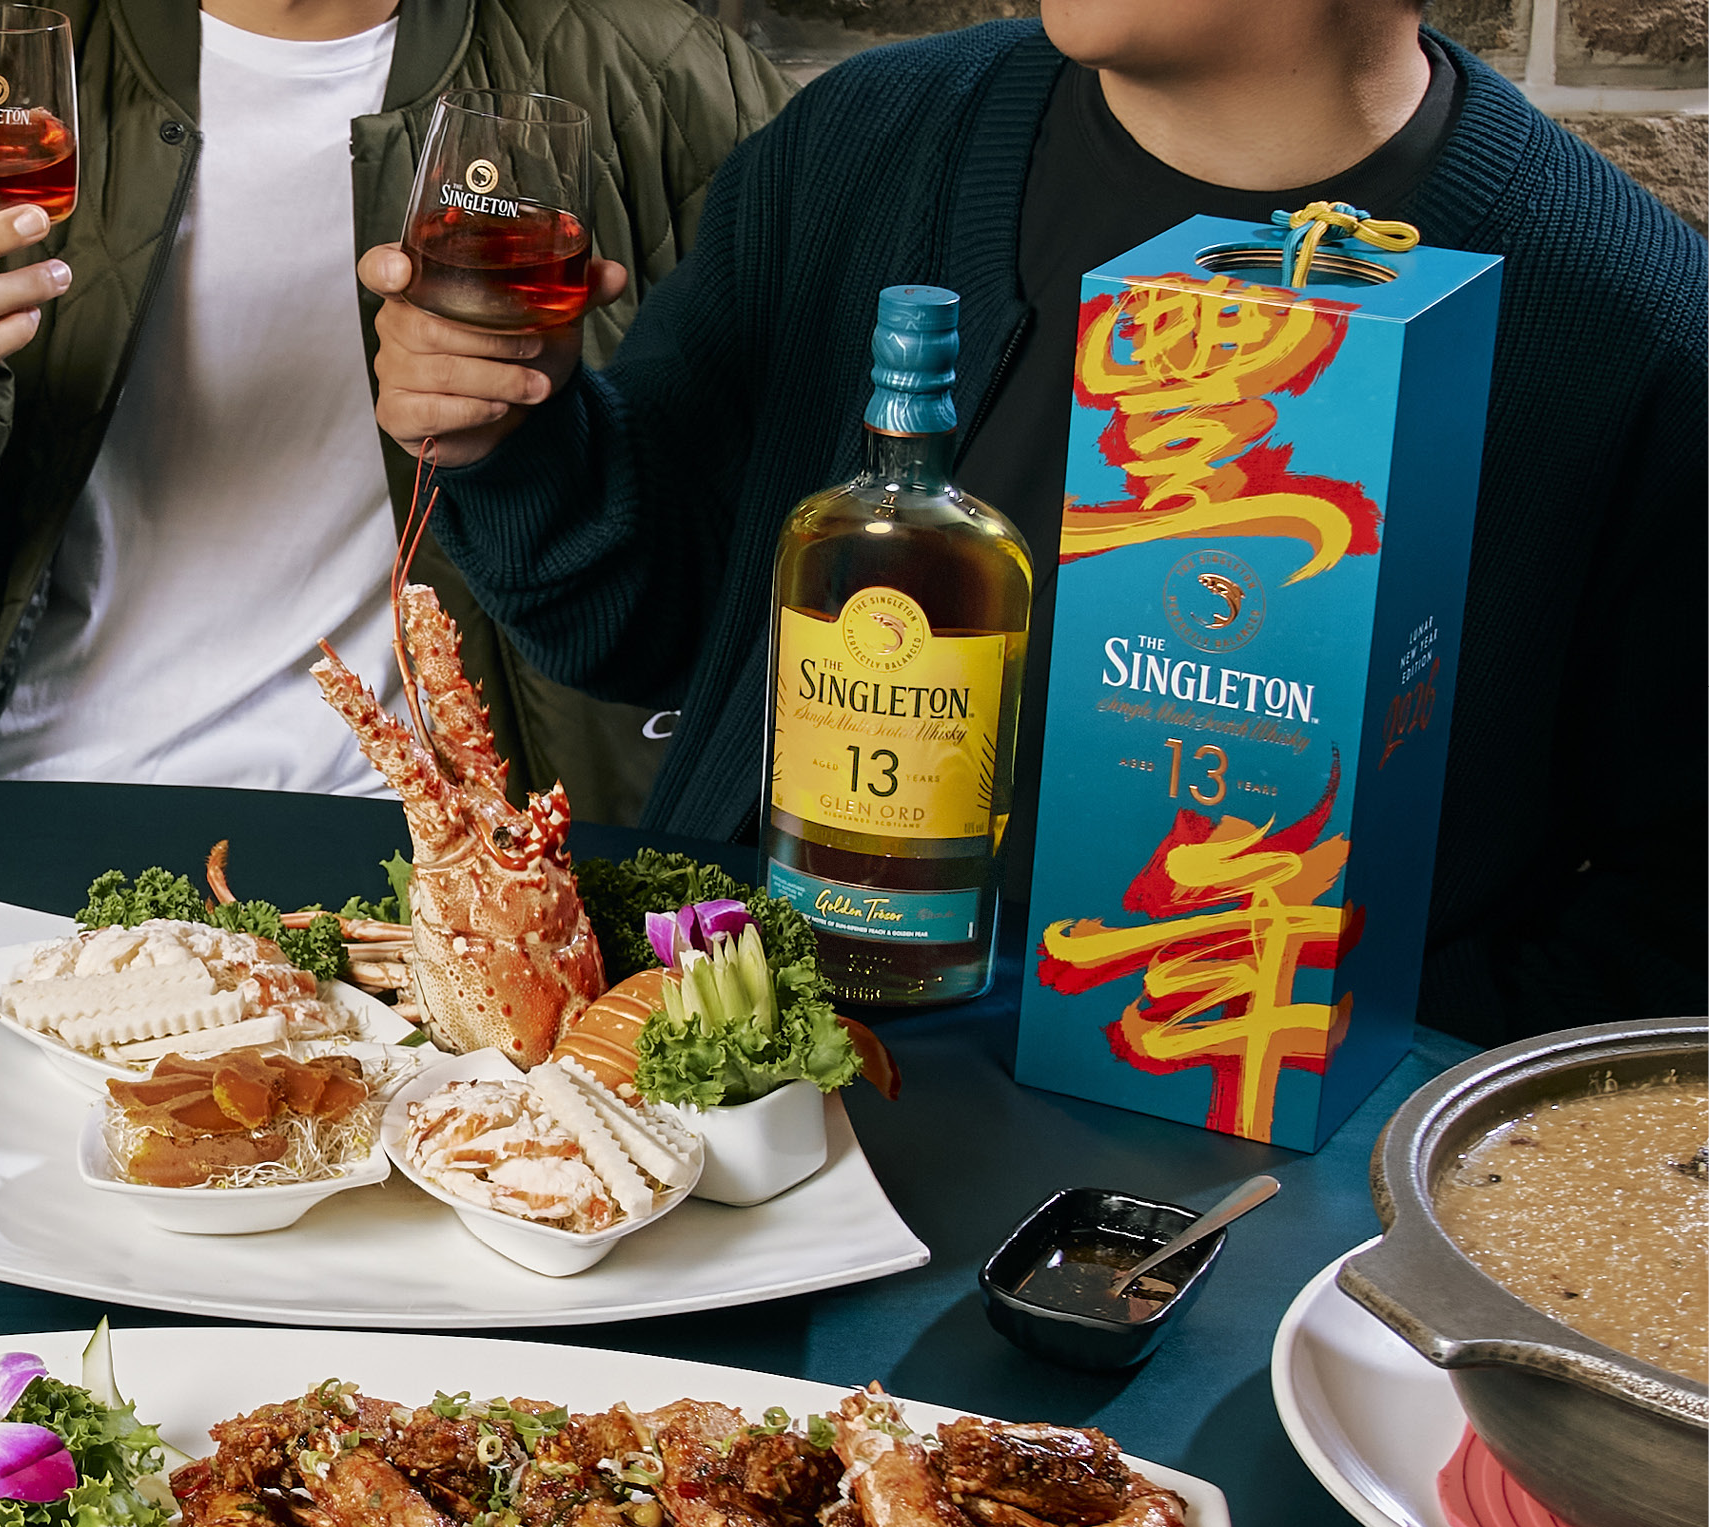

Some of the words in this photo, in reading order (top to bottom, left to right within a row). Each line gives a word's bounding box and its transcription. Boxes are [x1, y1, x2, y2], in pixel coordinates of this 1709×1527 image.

[440, 183, 519, 218] SINGLETON
[852, 600, 867, 615] THE
[869, 596, 917, 622] SINGLETON
[1137, 635, 1166, 652] THE
[1409, 616, 1433, 645] LUNAR
[823, 658, 843, 672] THE
[847, 629, 880, 669] PERFECTLY
[885, 637, 922, 670] BALANCED
[1399, 646, 1417, 669] NEW
[1420, 628, 1438, 652] YEAR
[1102, 636, 1315, 725] SINGLETON
[1401, 649, 1433, 685] EDITION
[799, 658, 970, 719] SINGLETON
[1377, 656, 1440, 771] 2026
[915, 721, 968, 745] Whisky
[812, 758, 839, 771] AGED
[846, 745, 899, 798] 13
[905, 774, 940, 783] YEARS
[1118, 758, 1155, 772] AGED
[1164, 737, 1229, 806] 13
[1236, 780, 1278, 797] YEARS
[819, 794, 872, 817] GLEN
[880, 805, 925, 821] ORD
[875, 820, 921, 829] SCOTLAND
[815, 888, 863, 918] Golden
